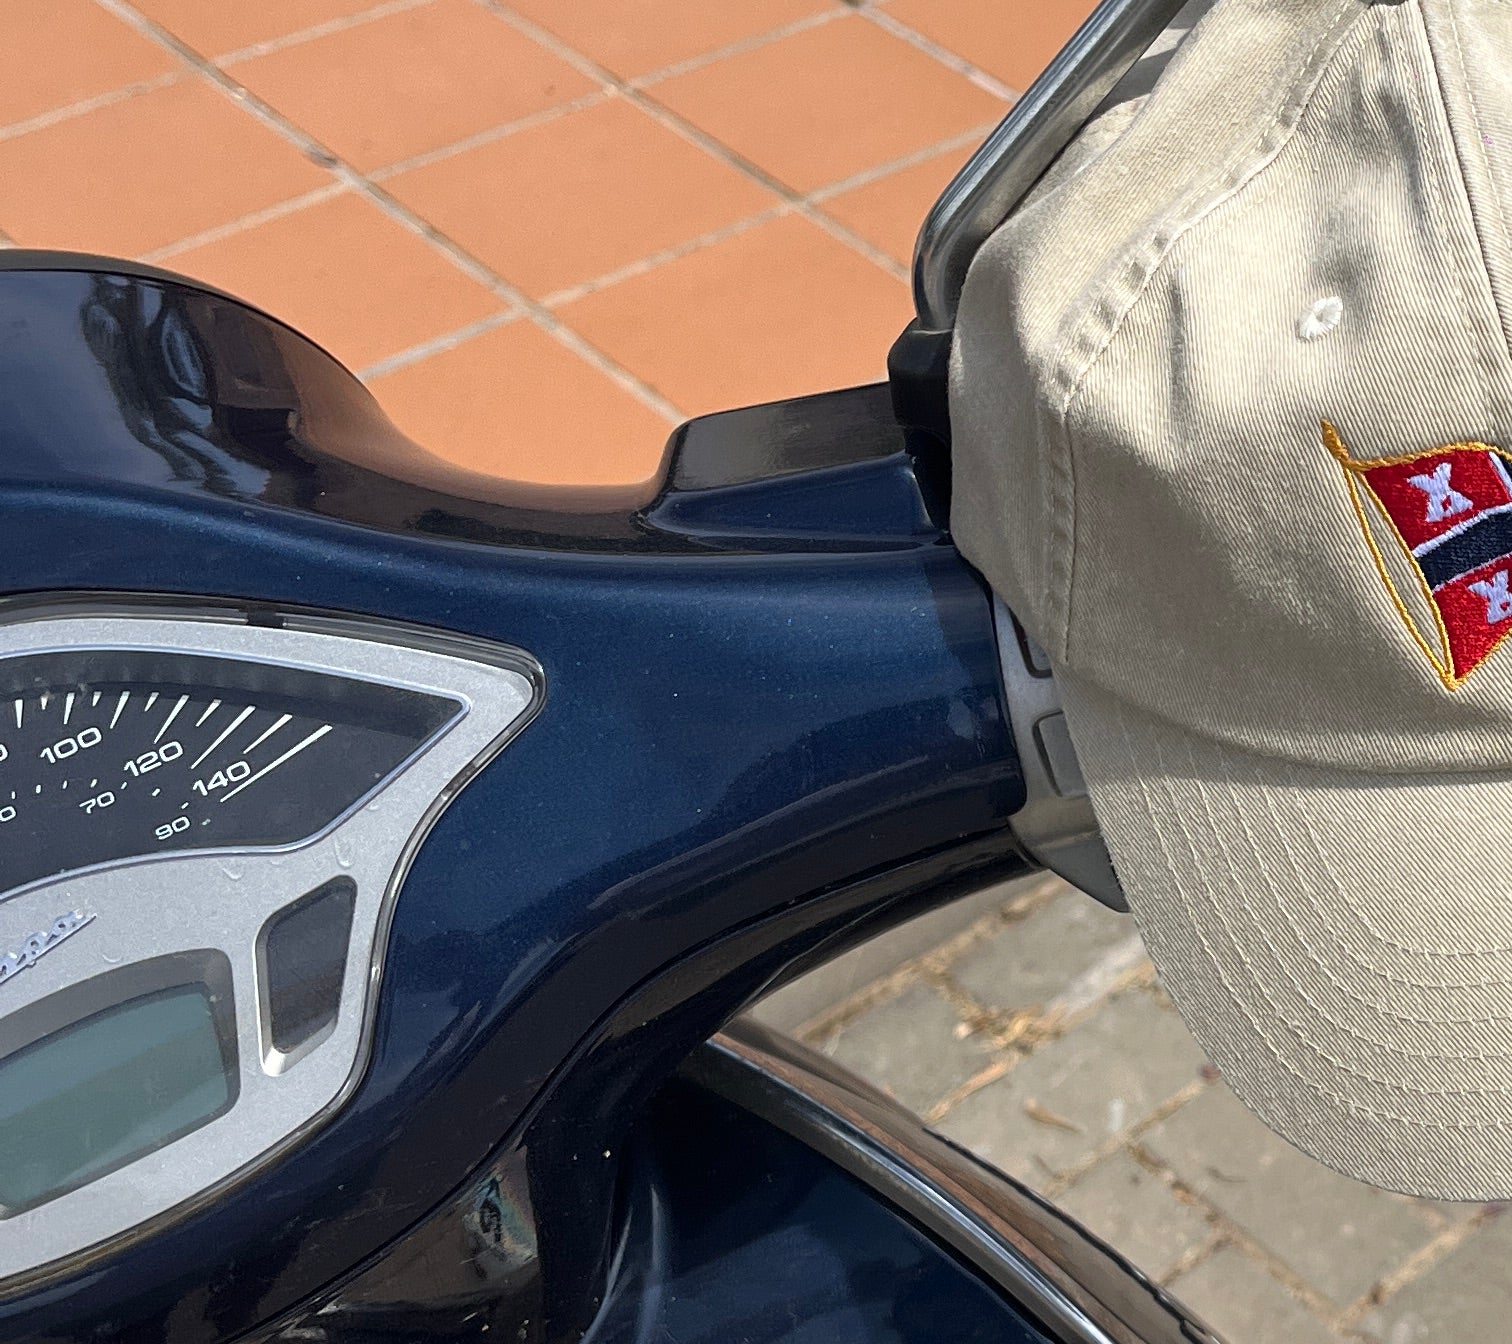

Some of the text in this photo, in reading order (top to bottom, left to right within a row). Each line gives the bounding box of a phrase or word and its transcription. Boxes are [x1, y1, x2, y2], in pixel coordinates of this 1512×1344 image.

[40, 727, 102, 764] 100
[123, 741, 184, 777] 120
[192, 760, 251, 796] 140
[79, 791, 116, 814] 70
[155, 816, 191, 841] 90
